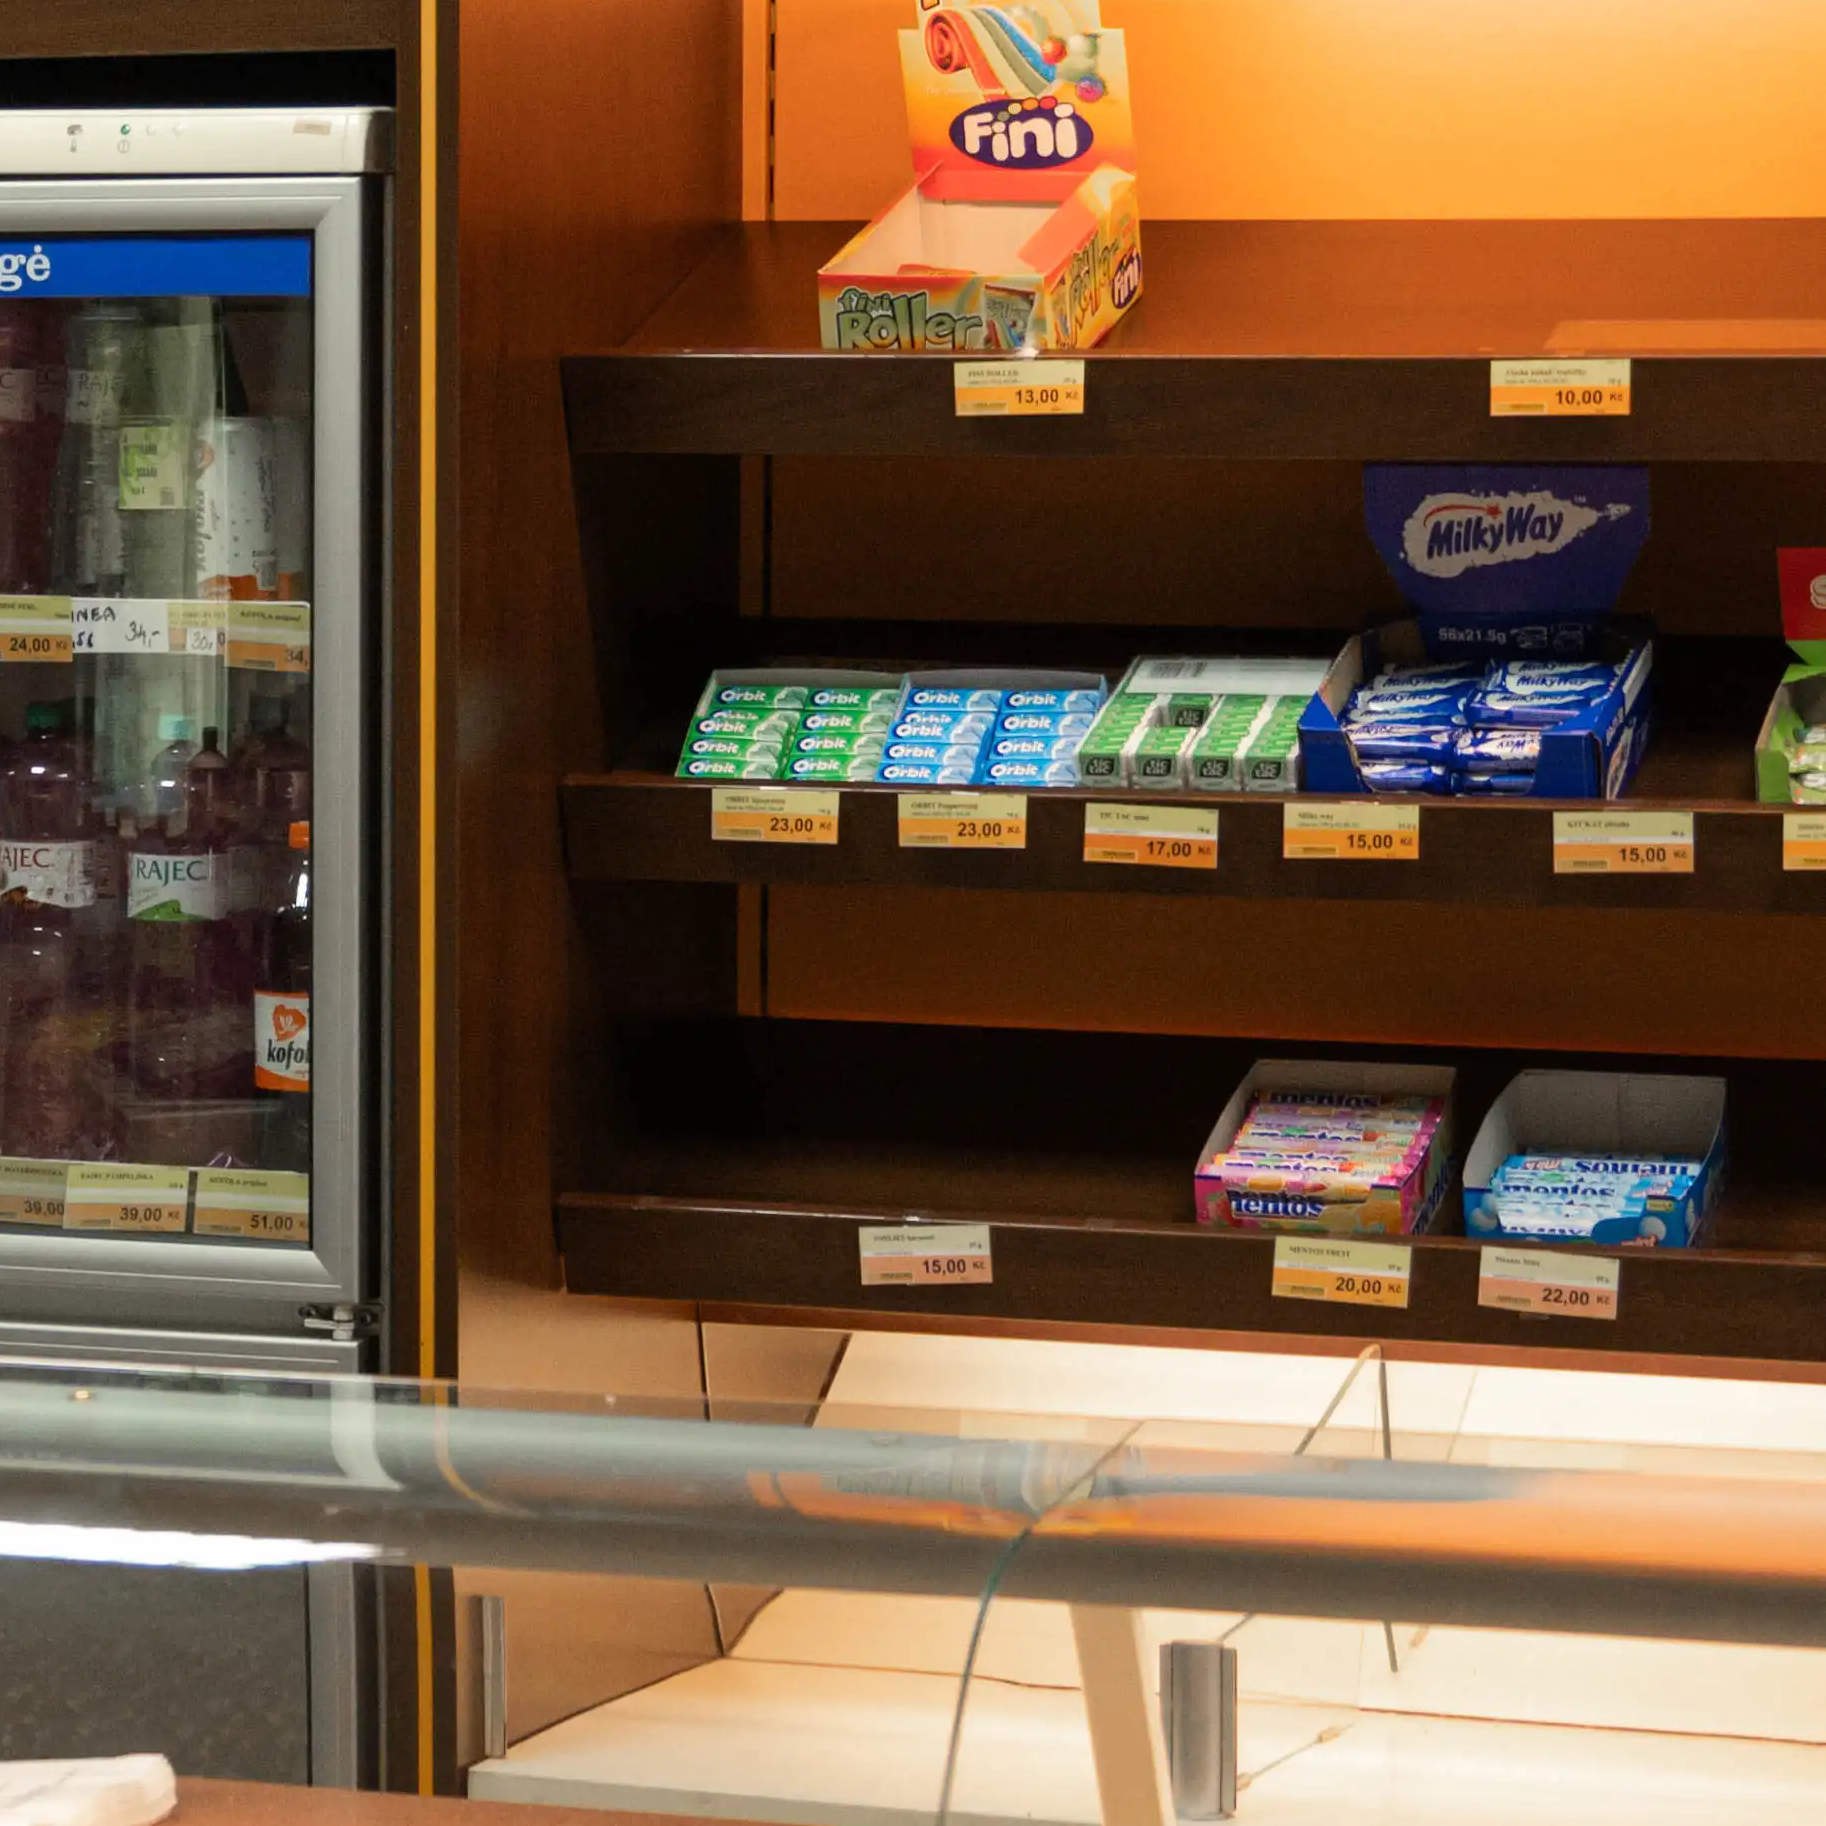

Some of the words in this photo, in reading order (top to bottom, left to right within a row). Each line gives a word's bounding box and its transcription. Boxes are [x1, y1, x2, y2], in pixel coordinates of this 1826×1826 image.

[963, 102, 1078, 162] Fini
[836, 290, 983, 349] Roller
[1015, 388, 1059, 406] 13,00
[1555, 390, 1602, 407] 10,00
[10, 637, 50, 654] 24,00
[285, 649, 308, 664] 34,
[720, 688, 767, 702] Orbit
[814, 690, 860, 704] Orbit
[914, 691, 960, 706] Orbit
[1009, 692, 1057, 706] Orbit
[698, 718, 747, 732] Orbit
[806, 714, 853, 729] Orbit
[1004, 715, 1051, 730] Orbit
[896, 723, 943, 737] Orbit
[692, 740, 739, 754] Orbit
[799, 736, 846, 751] Orbit
[997, 739, 1044, 754] Orbit
[889, 745, 936, 759] Orbit
[688, 760, 736, 774] Orbit
[793, 758, 840, 772] Orbit
[883, 765, 931, 779] Orbit
[990, 763, 1038, 777] Orbit
[770, 817, 813, 834] 23,00
[957, 822, 1002, 839] 23,00
[1346, 833, 1393, 850] 15,00
[1146, 840, 1192, 859] 17,00
[1618, 847, 1666, 864] 15,00
[136, 858, 207, 886] RAJEC
[24, 1200, 65, 1216] 39,00
[119, 1207, 162, 1222] 39,00
[250, 1214, 294, 1231] 51,00
[922, 1258, 966, 1277] 15,00
[1335, 1276, 1382, 1295] 20,00
[1542, 1287, 1590, 1306] 22,00
